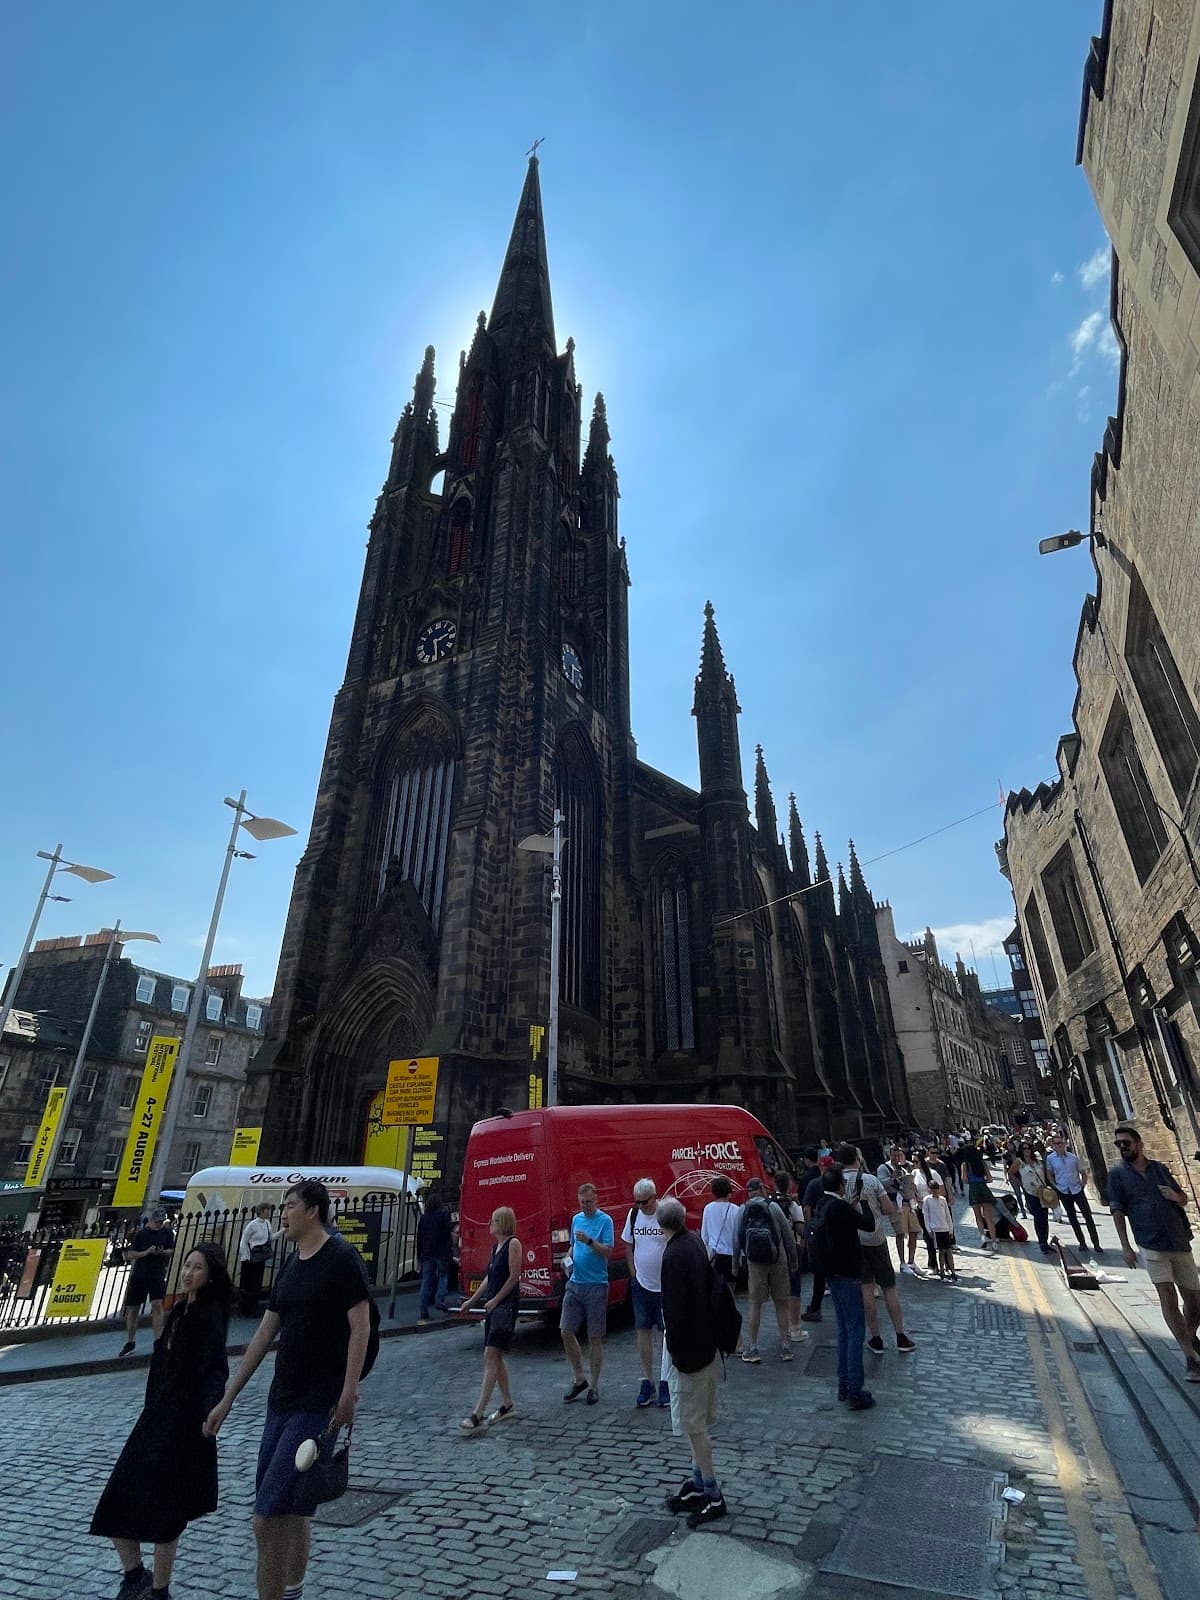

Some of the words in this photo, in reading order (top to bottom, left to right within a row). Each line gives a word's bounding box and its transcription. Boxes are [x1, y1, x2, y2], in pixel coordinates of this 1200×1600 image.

[142, 1097, 157, 1128] 4-27
[672, 1147, 695, 1159] PARCEL
[705, 1141, 742, 1160] FORCE
[128, 1131, 149, 1183] AUGUST
[474, 1160, 489, 1168] Express
[490, 1155, 513, 1166] Worldwide
[513, 1153, 535, 1162] Delivery
[31, 1148, 45, 1179] AUGUST
[714, 1162, 746, 1172] WORLDWIDE
[250, 1173, 283, 1184] Ice
[287, 1173, 350, 1184] Cream
[479, 1174, 527, 1186] www.parcelforce.com
[634, 1226, 665, 1236] adidas
[524, 1268, 550, 1279] FORCE
[52, 1294, 86, 1303] AUGUST
